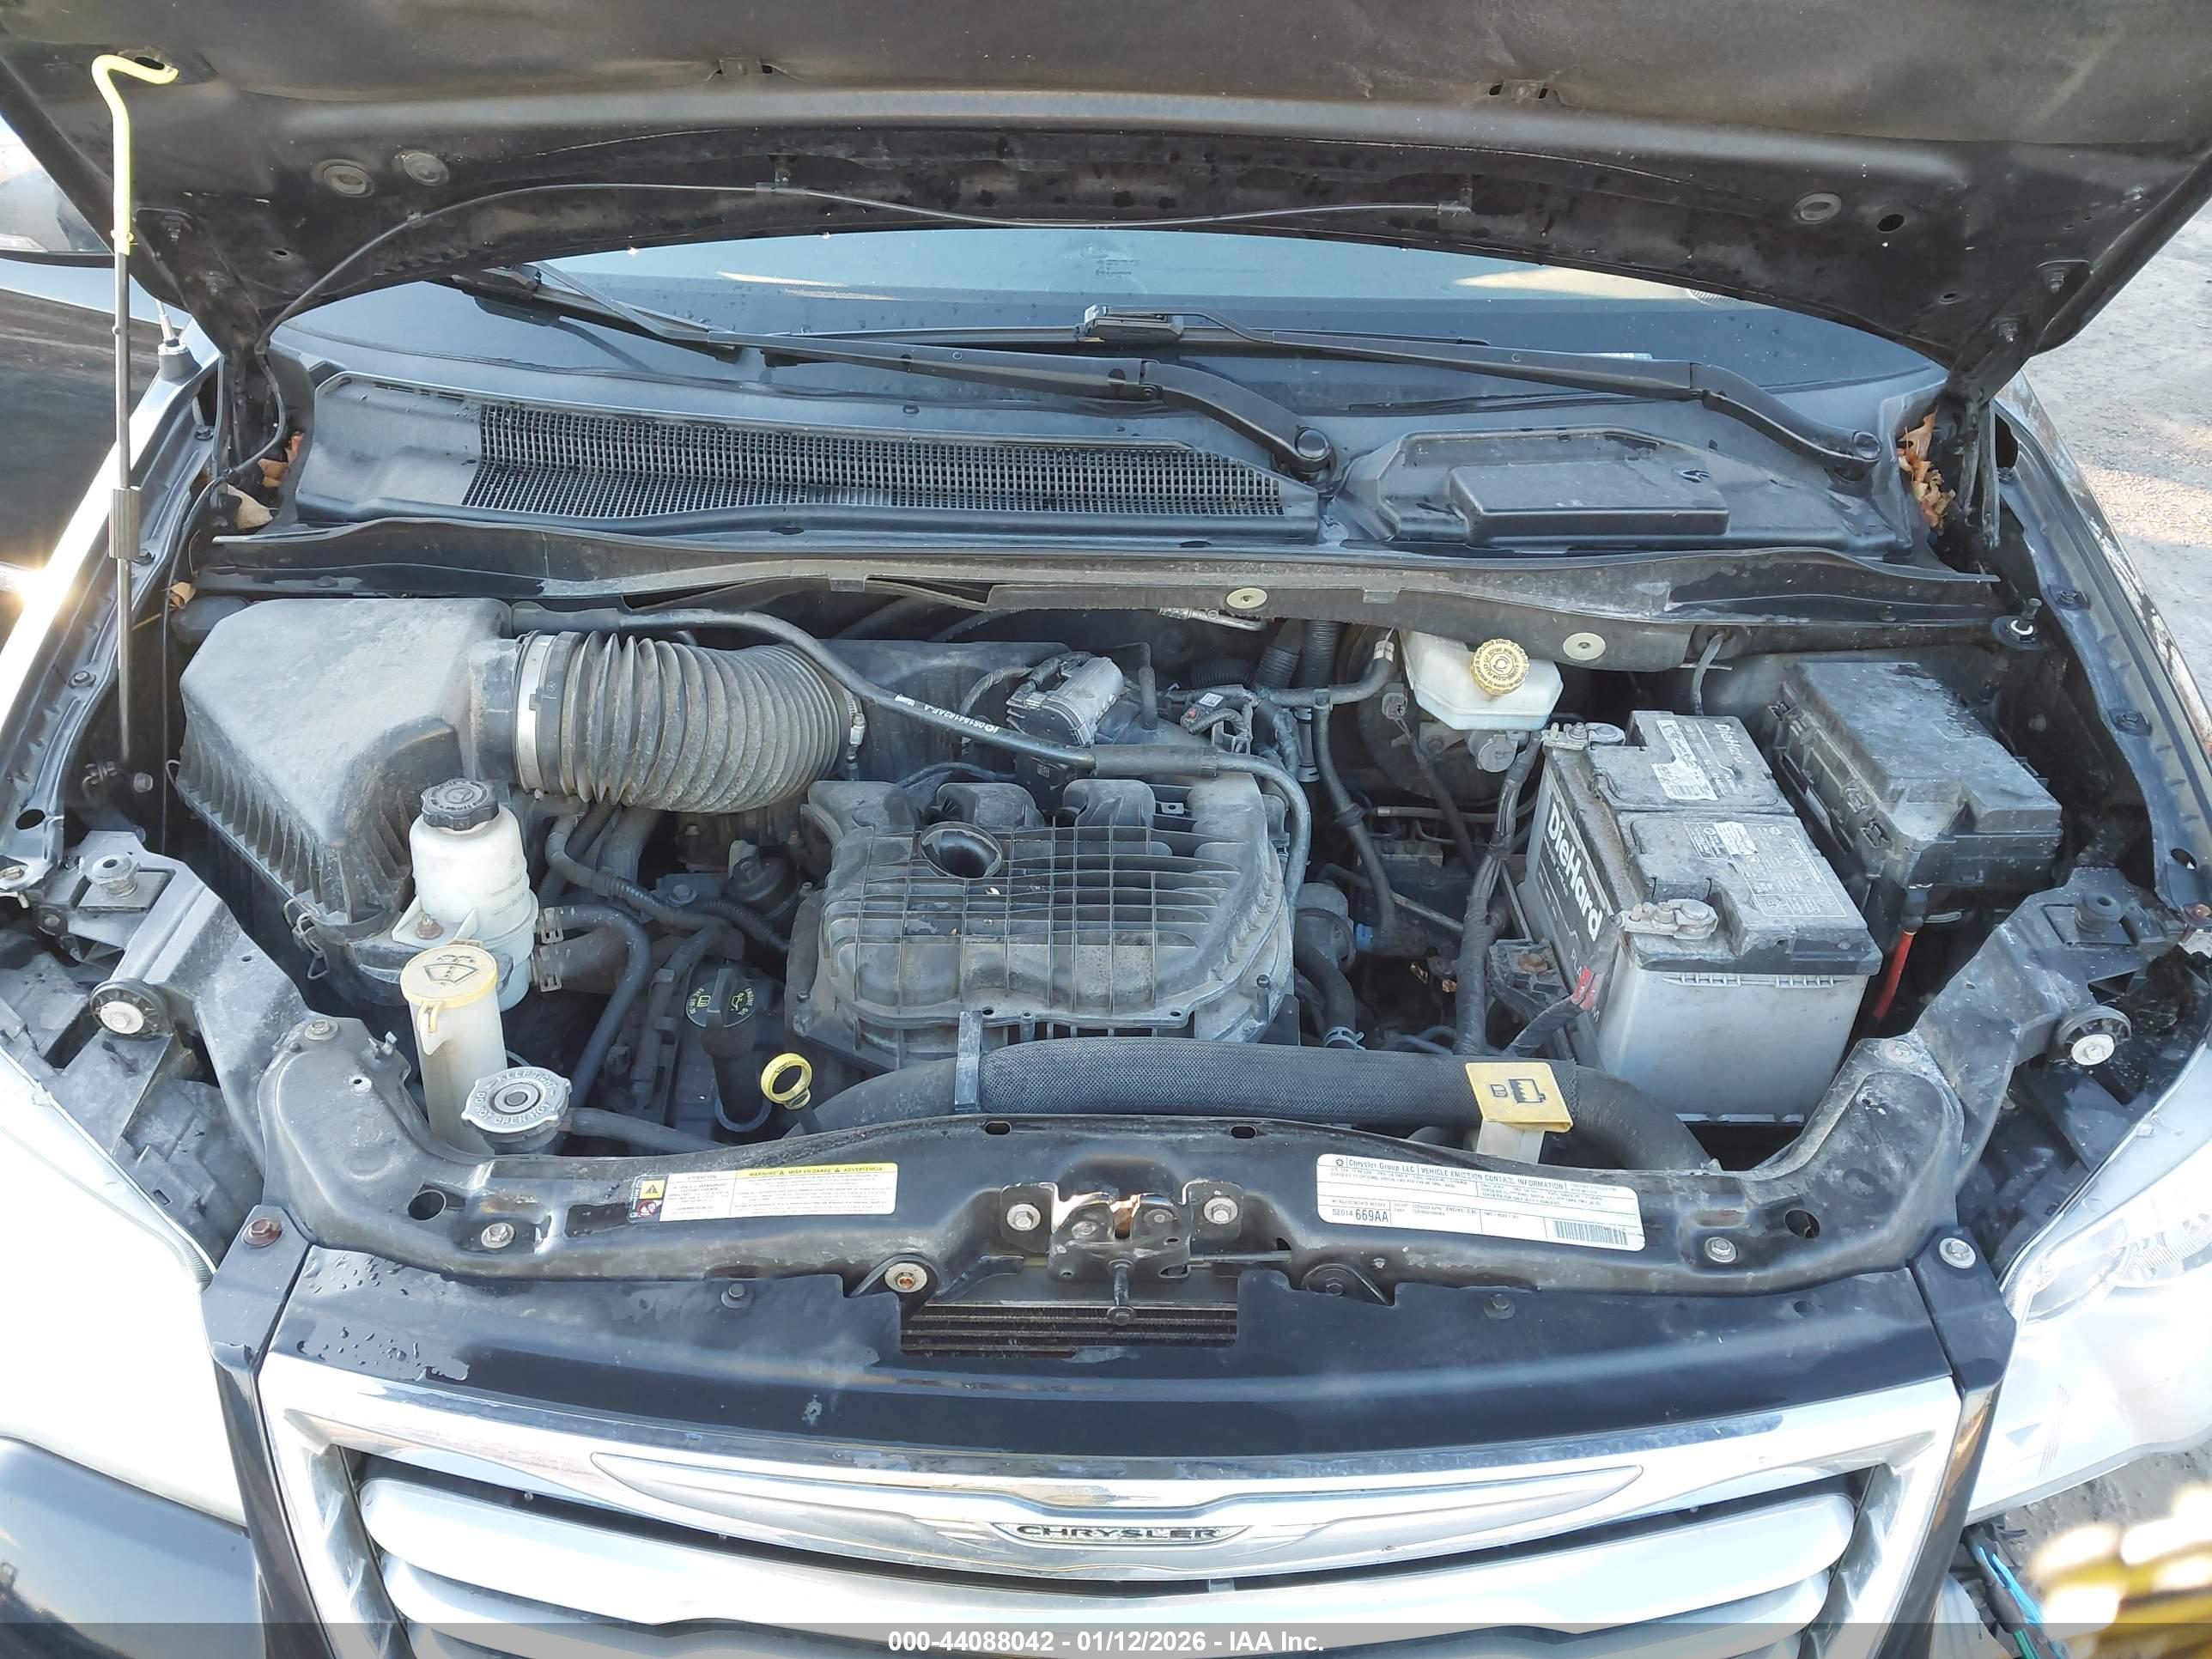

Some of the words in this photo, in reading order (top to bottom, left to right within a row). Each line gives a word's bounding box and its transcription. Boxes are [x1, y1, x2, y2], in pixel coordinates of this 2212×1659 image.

[1547, 803, 1603, 942] DieHard
[744, 988, 755, 1006] ENGINE
[738, 1007, 749, 1016] OIL
[494, 1116, 528, 1125] OPEN
[1349, 1159, 1376, 1169] Chrysler
[1379, 1163, 1400, 1171] Group
[1420, 1167, 1449, 1176] VEHICLE
[1450, 1170, 1483, 1181] EMISSION
[1485, 1174, 1513, 1183] CONTROL
[1517, 1178, 1563, 1190] INFORMATION
[1355, 1208, 1389, 1222] 669AA
[1018, 1526, 1219, 1539] CHRYSLER
